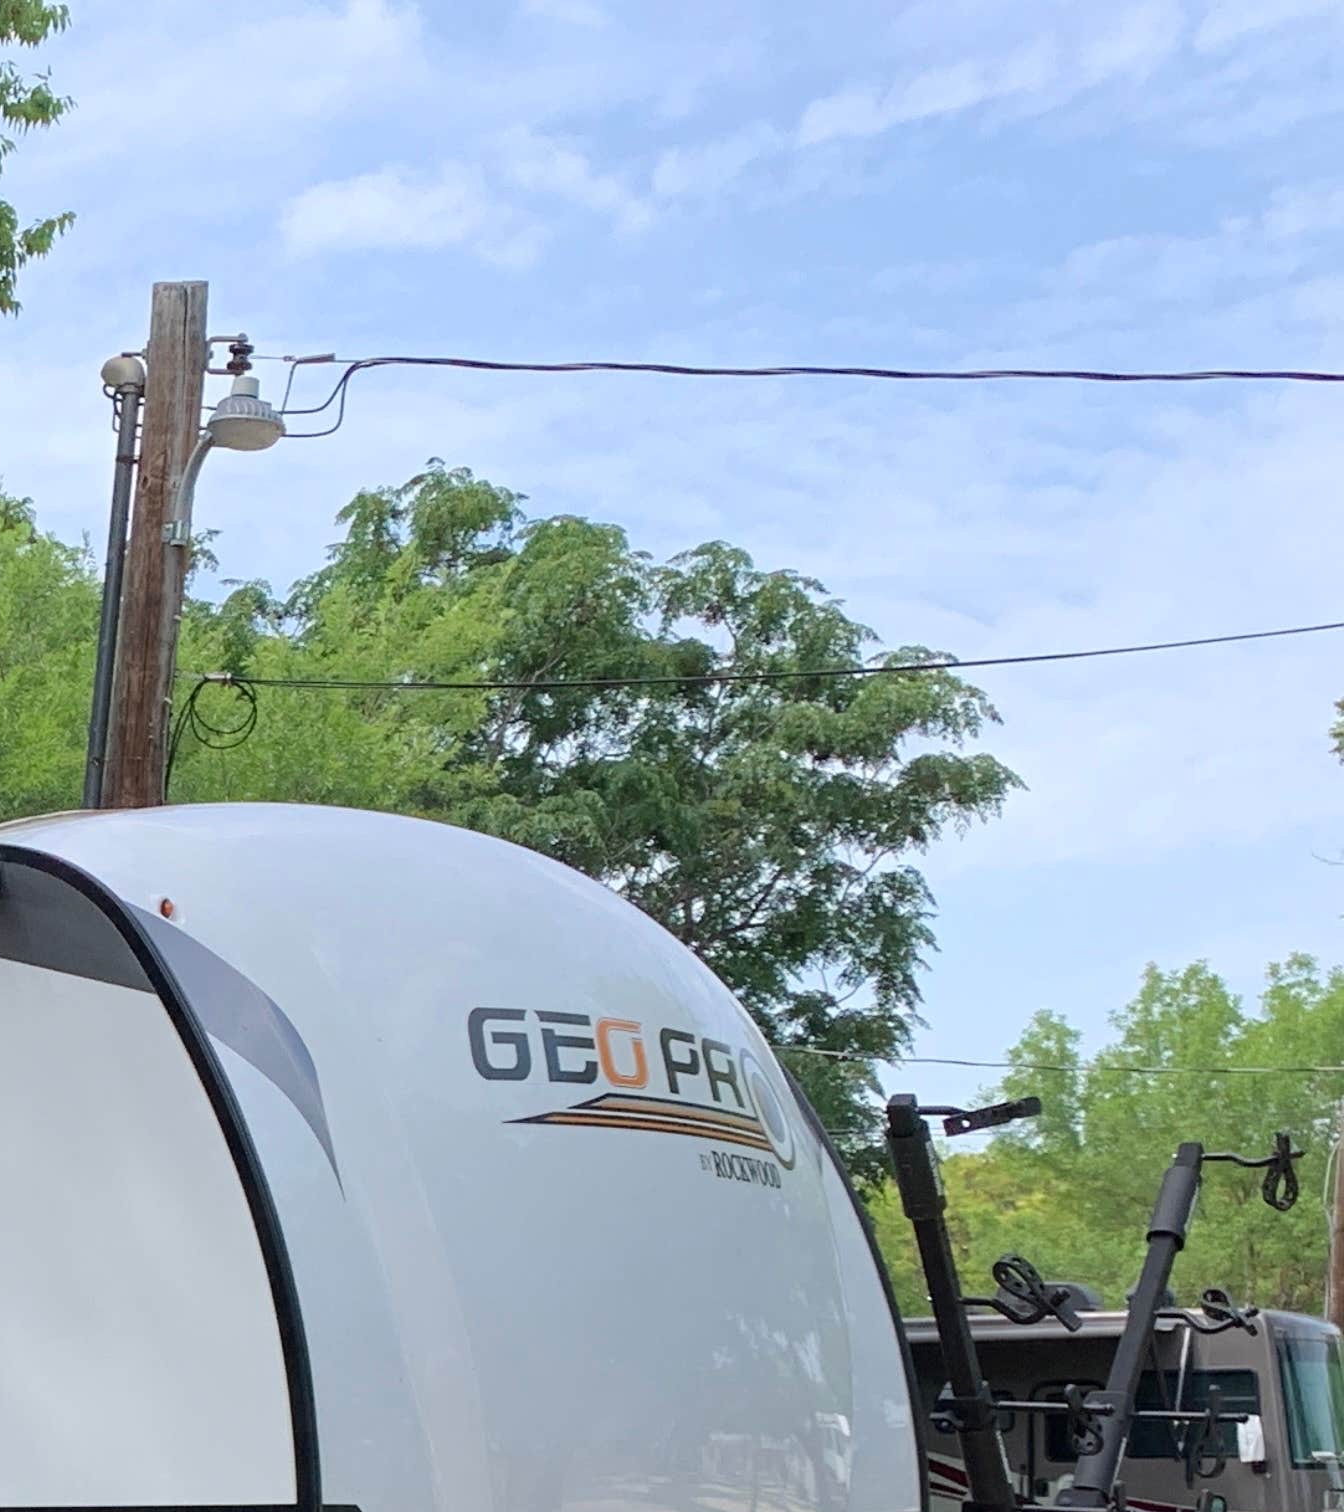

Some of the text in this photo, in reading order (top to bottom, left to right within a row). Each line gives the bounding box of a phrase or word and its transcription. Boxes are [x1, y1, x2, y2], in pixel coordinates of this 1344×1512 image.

[467, 1006, 648, 1089] GEO
[698, 1150, 782, 1189] BY ROCKWOOD
